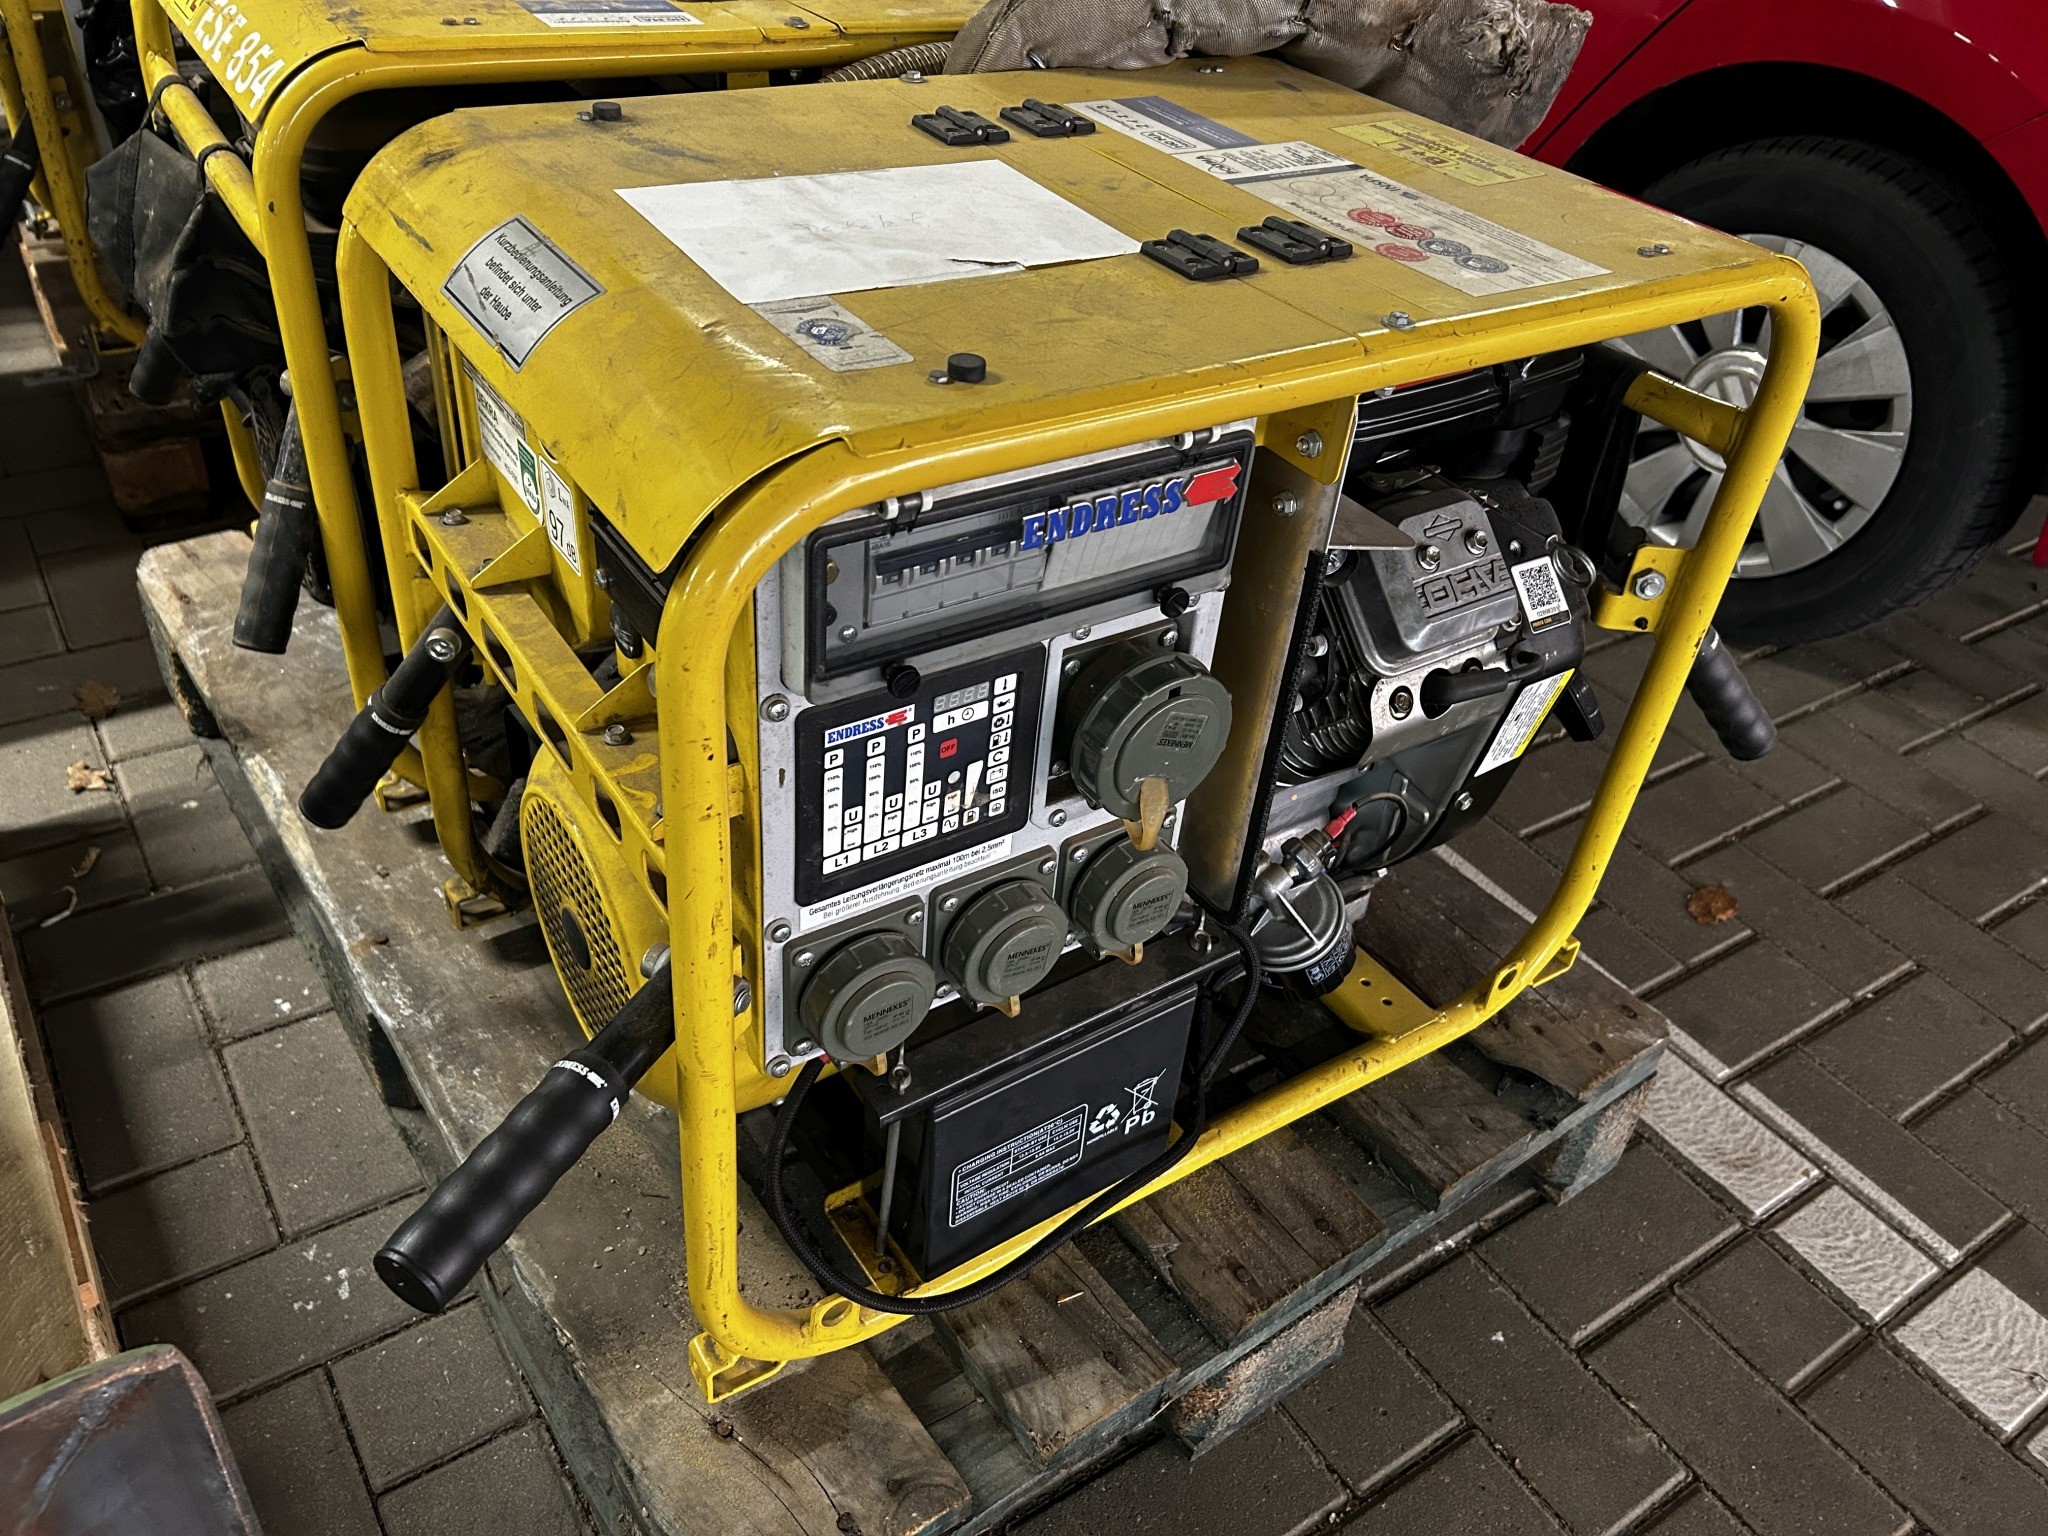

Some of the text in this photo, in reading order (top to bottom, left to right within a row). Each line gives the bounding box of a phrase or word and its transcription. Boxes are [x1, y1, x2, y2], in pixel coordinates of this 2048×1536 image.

[193, 0, 285, 109] ESE 854
[1355, 173, 1402, 192] INSPA
[494, 233, 573, 308] Kurzbedienungsanleitung
[485, 256, 542, 312] befindet sich unter
[480, 286, 512, 320] der Haube
[476, 388, 498, 426] DEKRA
[1020, 478, 1184, 551] ENDRESS
[549, 510, 565, 547] 97
[567, 541, 578, 564] dB
[828, 717, 884, 744] ENDRESS
[948, 716, 954, 726] h
[912, 728, 921, 740] P
[1159, 738, 1194, 749] MENNEKES
[872, 742, 881, 752] P
[941, 744, 956, 754] OFF
[830, 754, 839, 765] P
[928, 786, 937, 796] U
[992, 786, 1004, 795] ISO
[890, 799, 898, 808] U
[849, 811, 858, 821] U
[912, 828, 927, 842] L3
[874, 842, 889, 854] L2
[834, 855, 849, 868] L1
[808, 899, 841, 916] Gesamtes
[842, 868, 925, 904] Leitungsverlängerungsnetz
[926, 858, 951, 876] maximal
[952, 853, 970, 864] 100m
[970, 848, 980, 858] bei
[823, 910, 834, 920] Bei
[835, 901, 861, 917] größerer
[902, 864, 962, 892] Bedienungsanleitung
[1132, 894, 1168, 910] MENNEKES
[1008, 946, 1046, 960] MENNEKES
[864, 1001, 908, 1022] MENNEKES
[1051, 1118, 1078, 1135] CYCLIC USE
[1124, 1110, 1156, 1134] Pb
[962, 1150, 996, 1172] CHARGING
[959, 1160, 1009, 1188] VOLTAGE REGULATION
[964, 1170, 1004, 1194] INITIAL CURRENT
[956, 1186, 986, 1206] CAUTION:
[974, 1190, 989, 1201] SHORT
